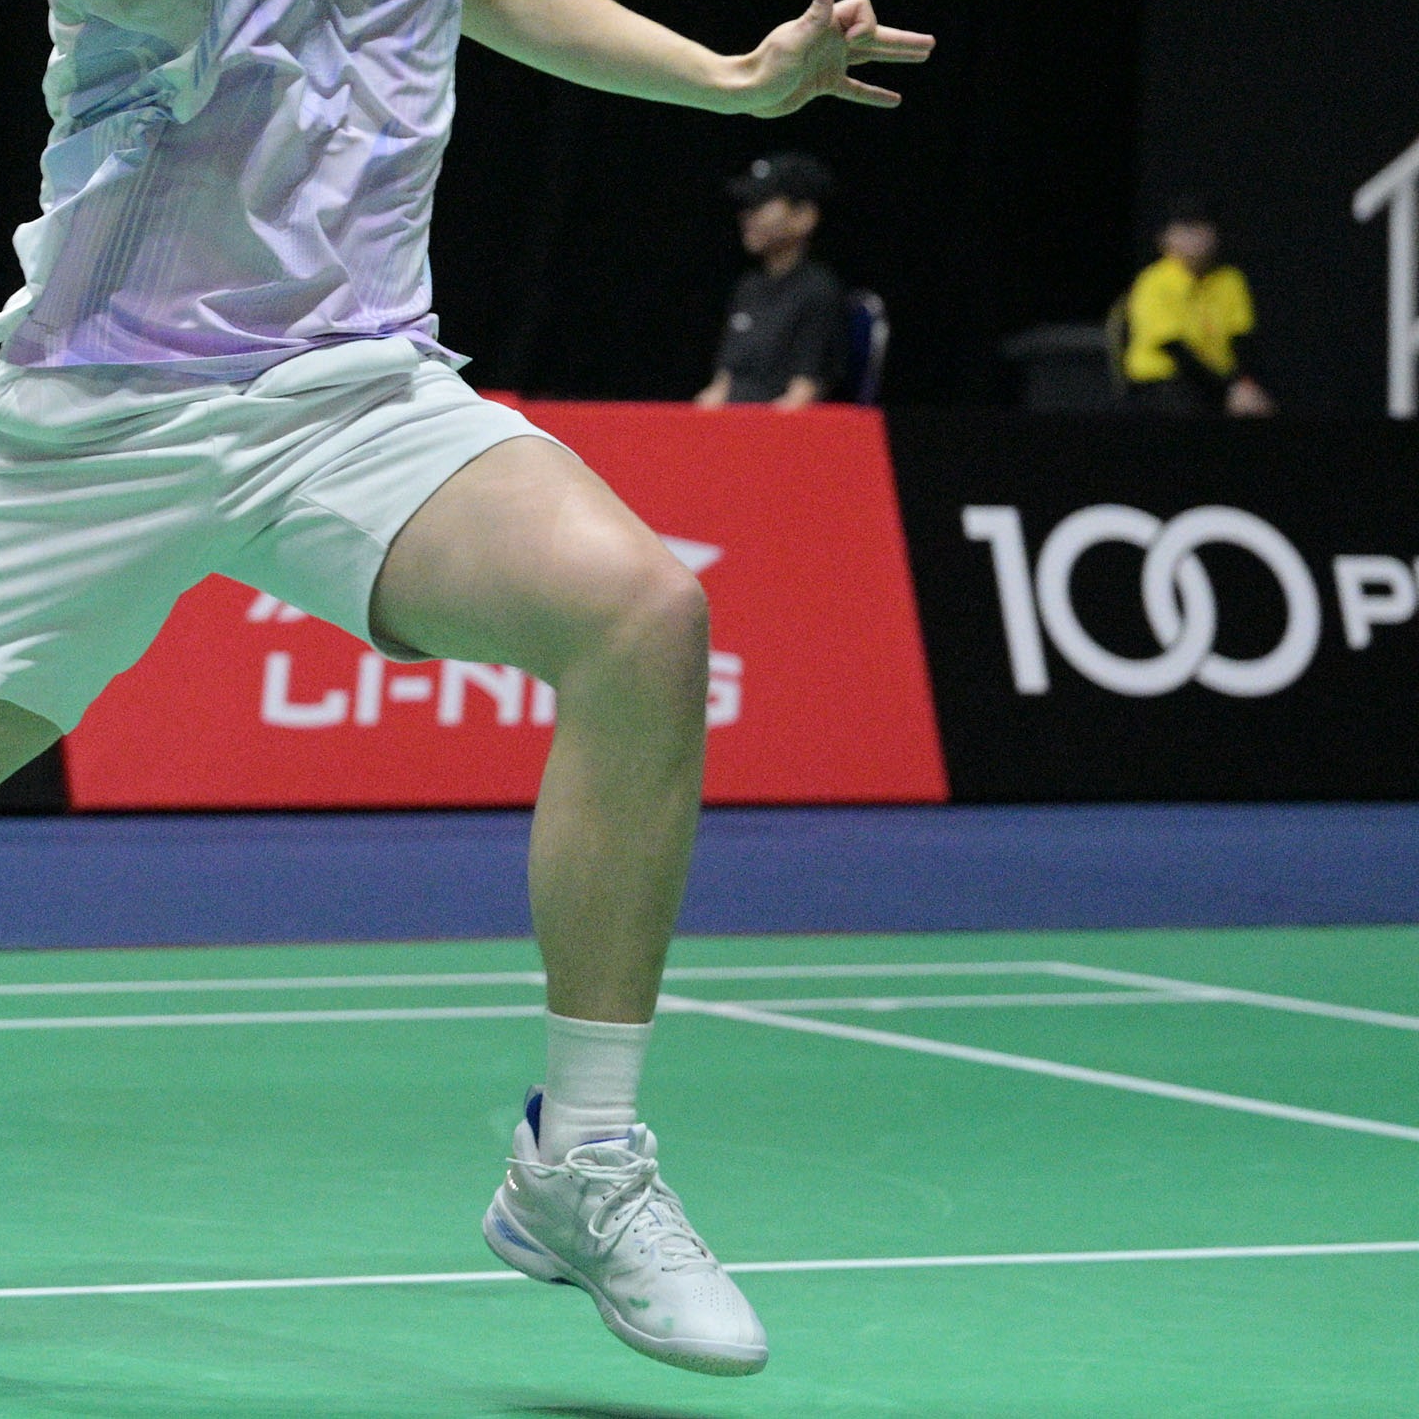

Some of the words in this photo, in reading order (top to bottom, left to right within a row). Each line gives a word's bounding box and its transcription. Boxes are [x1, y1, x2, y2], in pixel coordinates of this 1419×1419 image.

[960, 502, 1323, 698] 100
[1331, 553, 1419, 651] P
[259, 651, 743, 729] LI-NI
